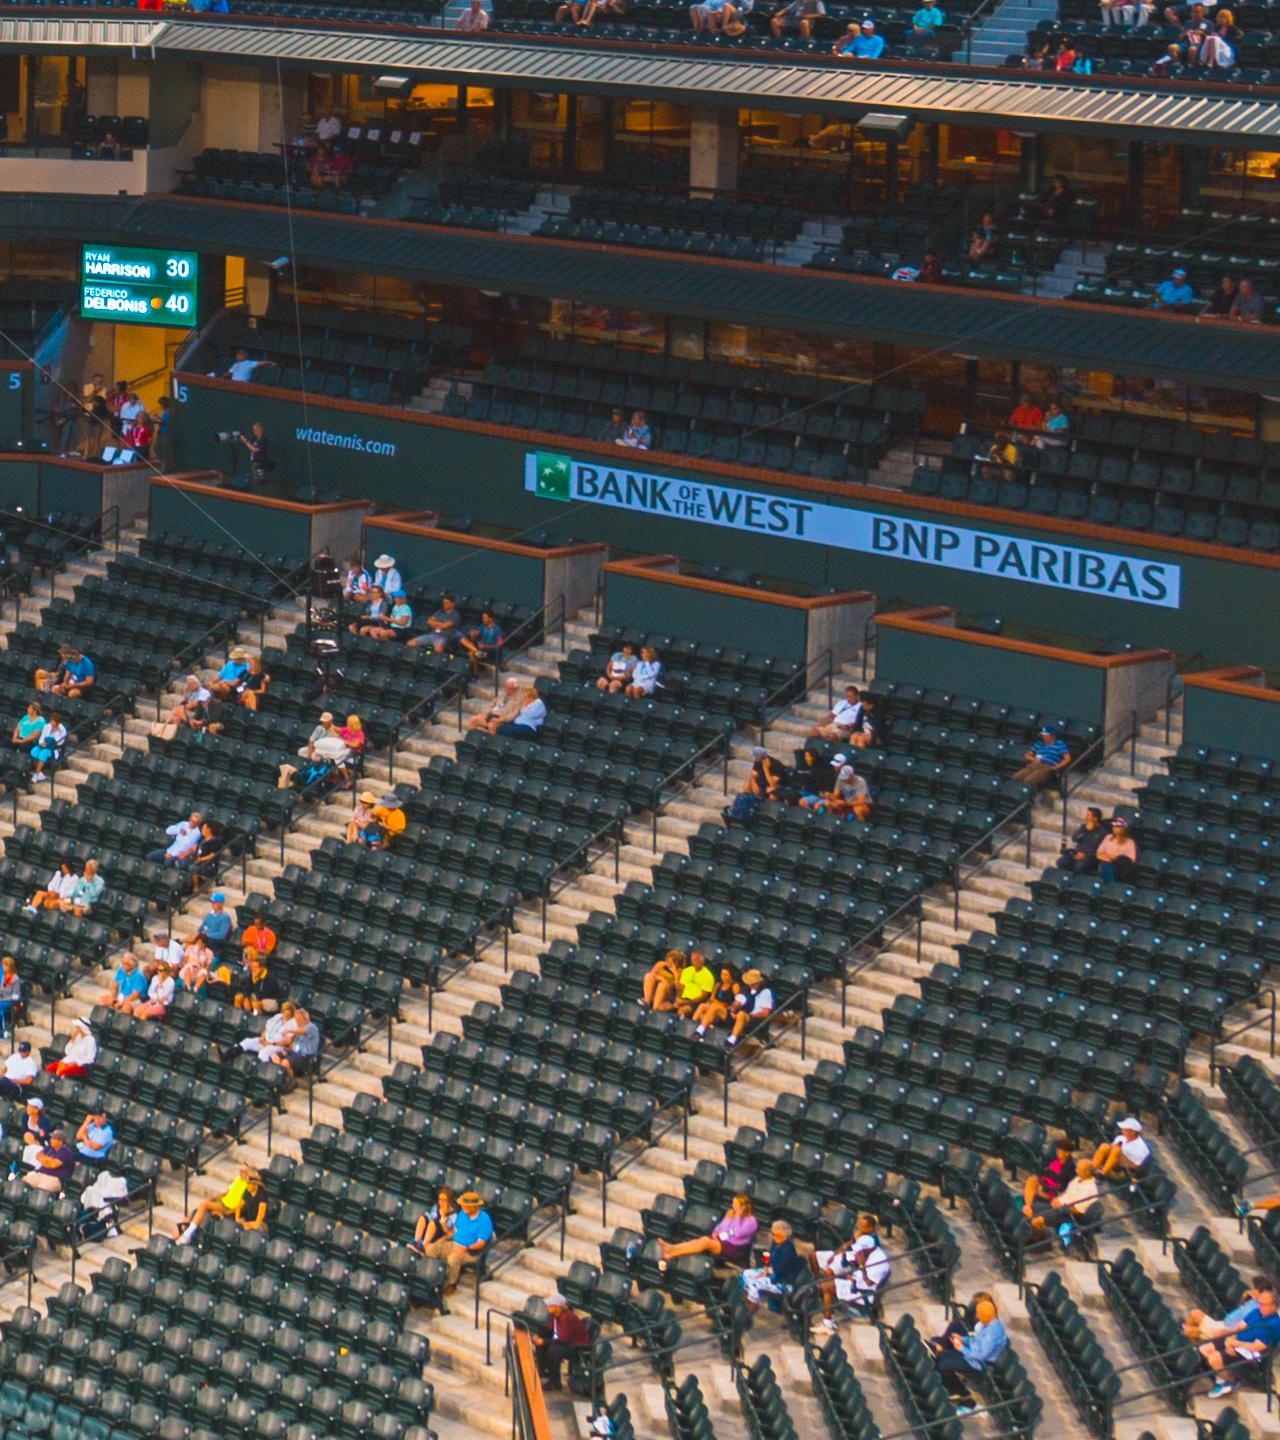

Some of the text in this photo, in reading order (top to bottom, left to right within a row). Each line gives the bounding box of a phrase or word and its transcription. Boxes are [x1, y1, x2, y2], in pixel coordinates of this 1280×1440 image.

[85, 252, 190, 277] RYAN 30
[85, 262, 151, 278] HARRISON
[84, 288, 189, 313] FEDERICO 40
[84, 297, 148, 313] DELBONIS
[8, 373, 21, 389] 5
[178, 386, 188, 402] 5
[296, 427, 396, 456] wtatennis.com
[576, 466, 1168, 601] BANK OF THE WEST BNP PARIBAS
